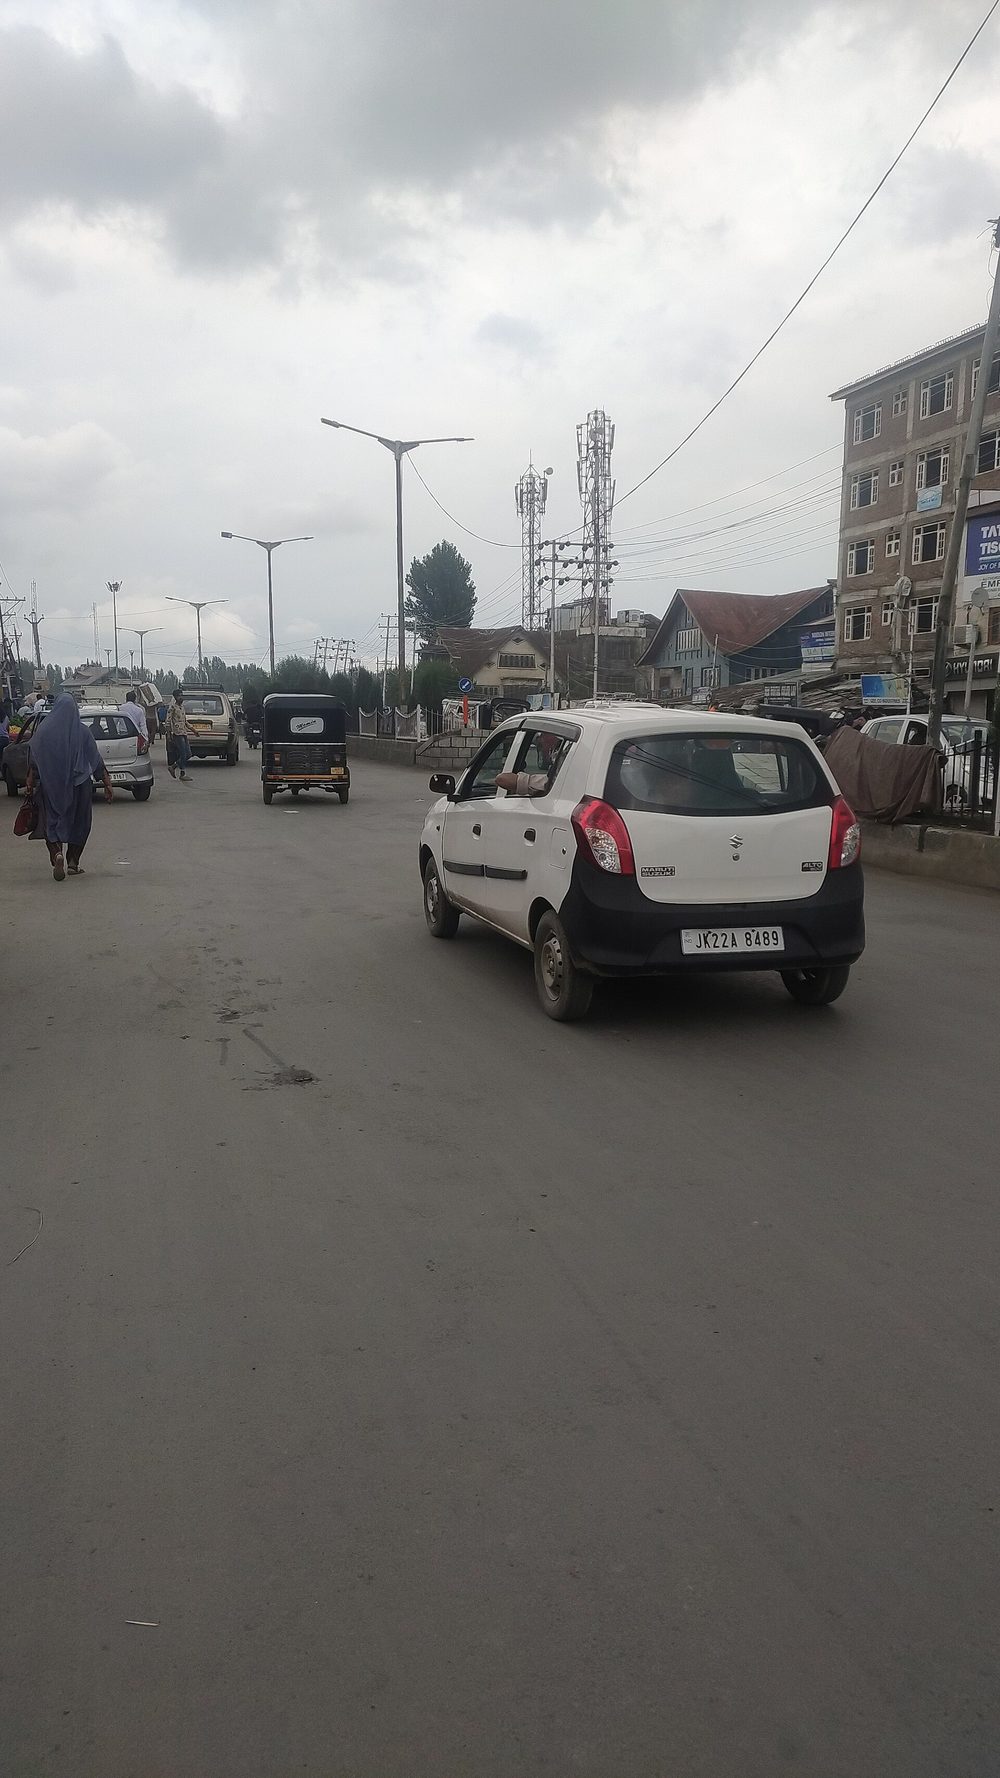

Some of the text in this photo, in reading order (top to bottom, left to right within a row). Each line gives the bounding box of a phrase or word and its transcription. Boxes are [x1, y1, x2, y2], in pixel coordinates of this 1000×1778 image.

[979, 541, 1000, 555] TIS
[978, 562, 997, 571] JOY OF
[695, 930, 779, 949] JK22A 8489
